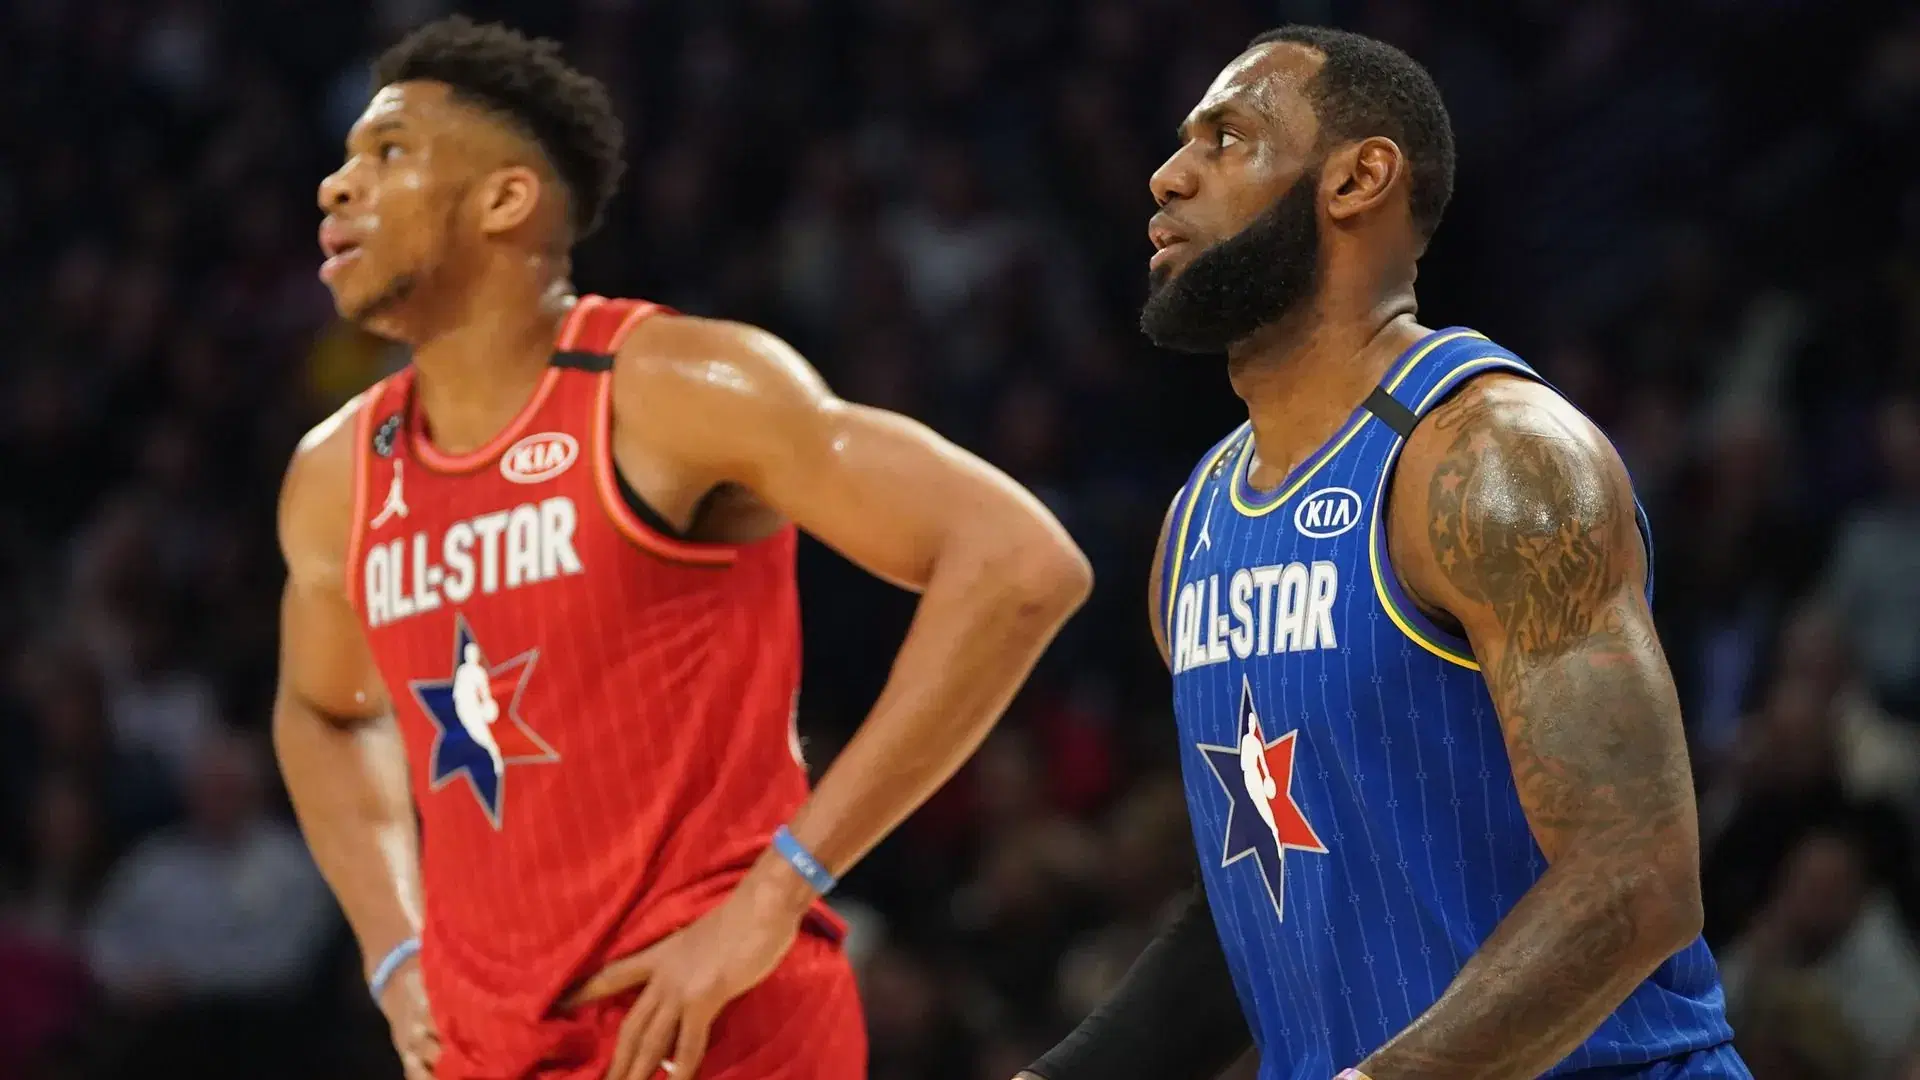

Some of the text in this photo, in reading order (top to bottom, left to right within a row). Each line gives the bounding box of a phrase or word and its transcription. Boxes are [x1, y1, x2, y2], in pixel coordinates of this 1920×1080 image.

[512, 440, 567, 473] KIA
[1304, 498, 1350, 528] KIA
[365, 496, 584, 628] ALL-STAR
[1174, 560, 1338, 675] ALL-STAR
